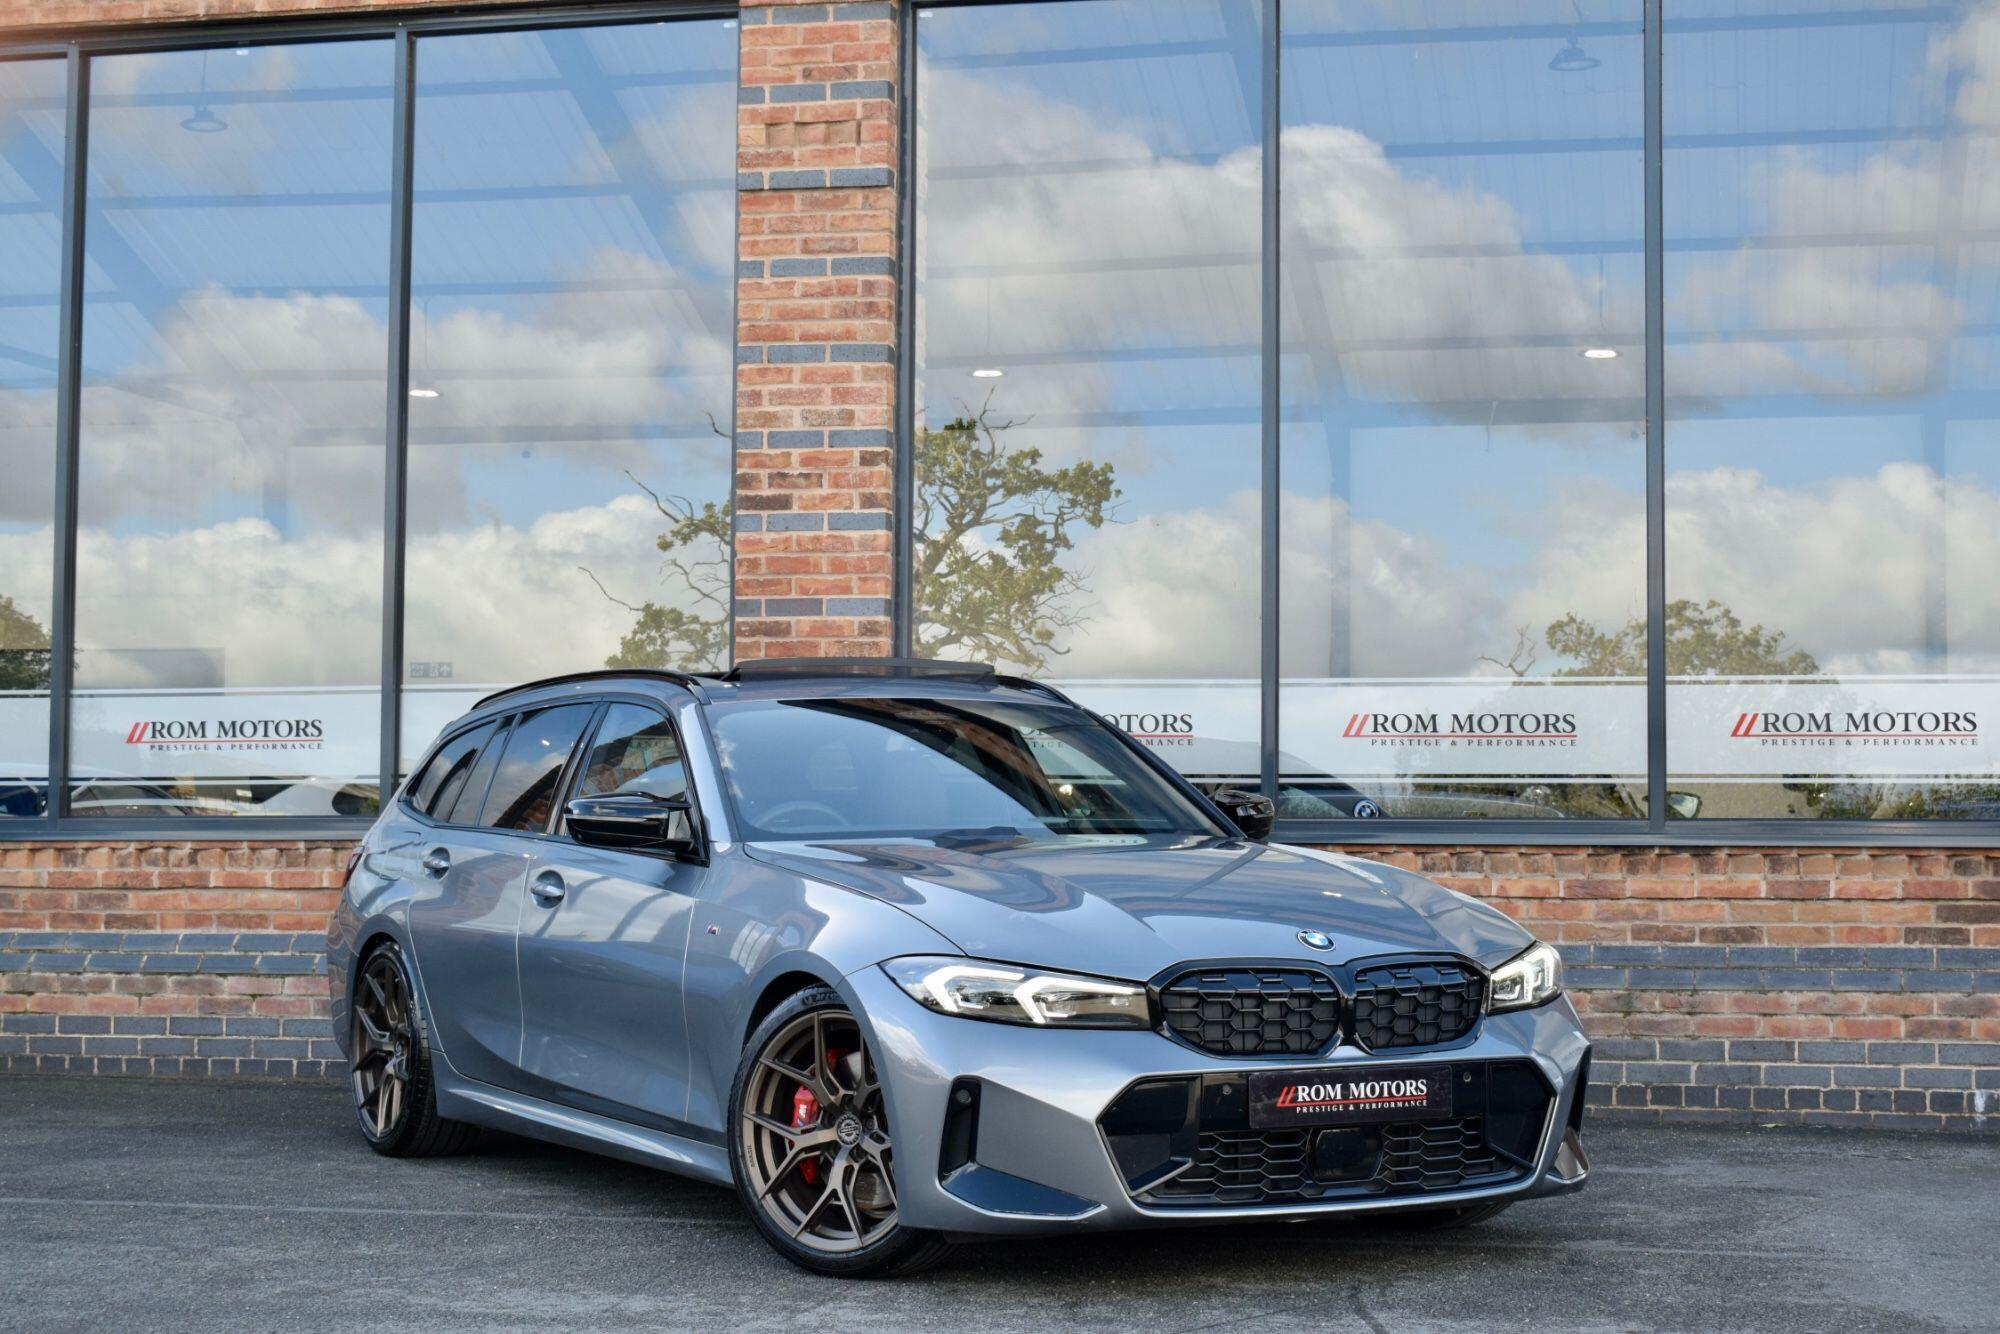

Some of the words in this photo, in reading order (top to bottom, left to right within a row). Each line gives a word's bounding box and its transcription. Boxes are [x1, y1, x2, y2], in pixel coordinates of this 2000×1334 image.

[151, 721, 207, 739] ROM
[217, 719, 323, 738] MOTORS
[1102, 713, 1193, 733] TORS
[1371, 713, 1438, 734] ROM
[1450, 713, 1576, 734] MOTORS
[1762, 712, 1831, 733] ROM
[1845, 712, 1978, 733] MOTORS
[230, 742, 324, 750] PERFORMANCE
[1371, 738, 1442, 747] PRESTIGE
[1450, 738, 1457, 747] &
[1467, 738, 1577, 747] PERFORMANCE
[1761, 738, 1836, 746] PRESTIGE
[1845, 738, 1852, 746] &
[1863, 738, 1978, 746] PERFORMANCE
[1297, 1084, 1343, 1102] ROM
[1349, 1079, 1427, 1099] MOTORS
[1296, 1104, 1344, 1114] PRESTIGE
[1360, 1099, 1428, 1110] PERFORMANCE
